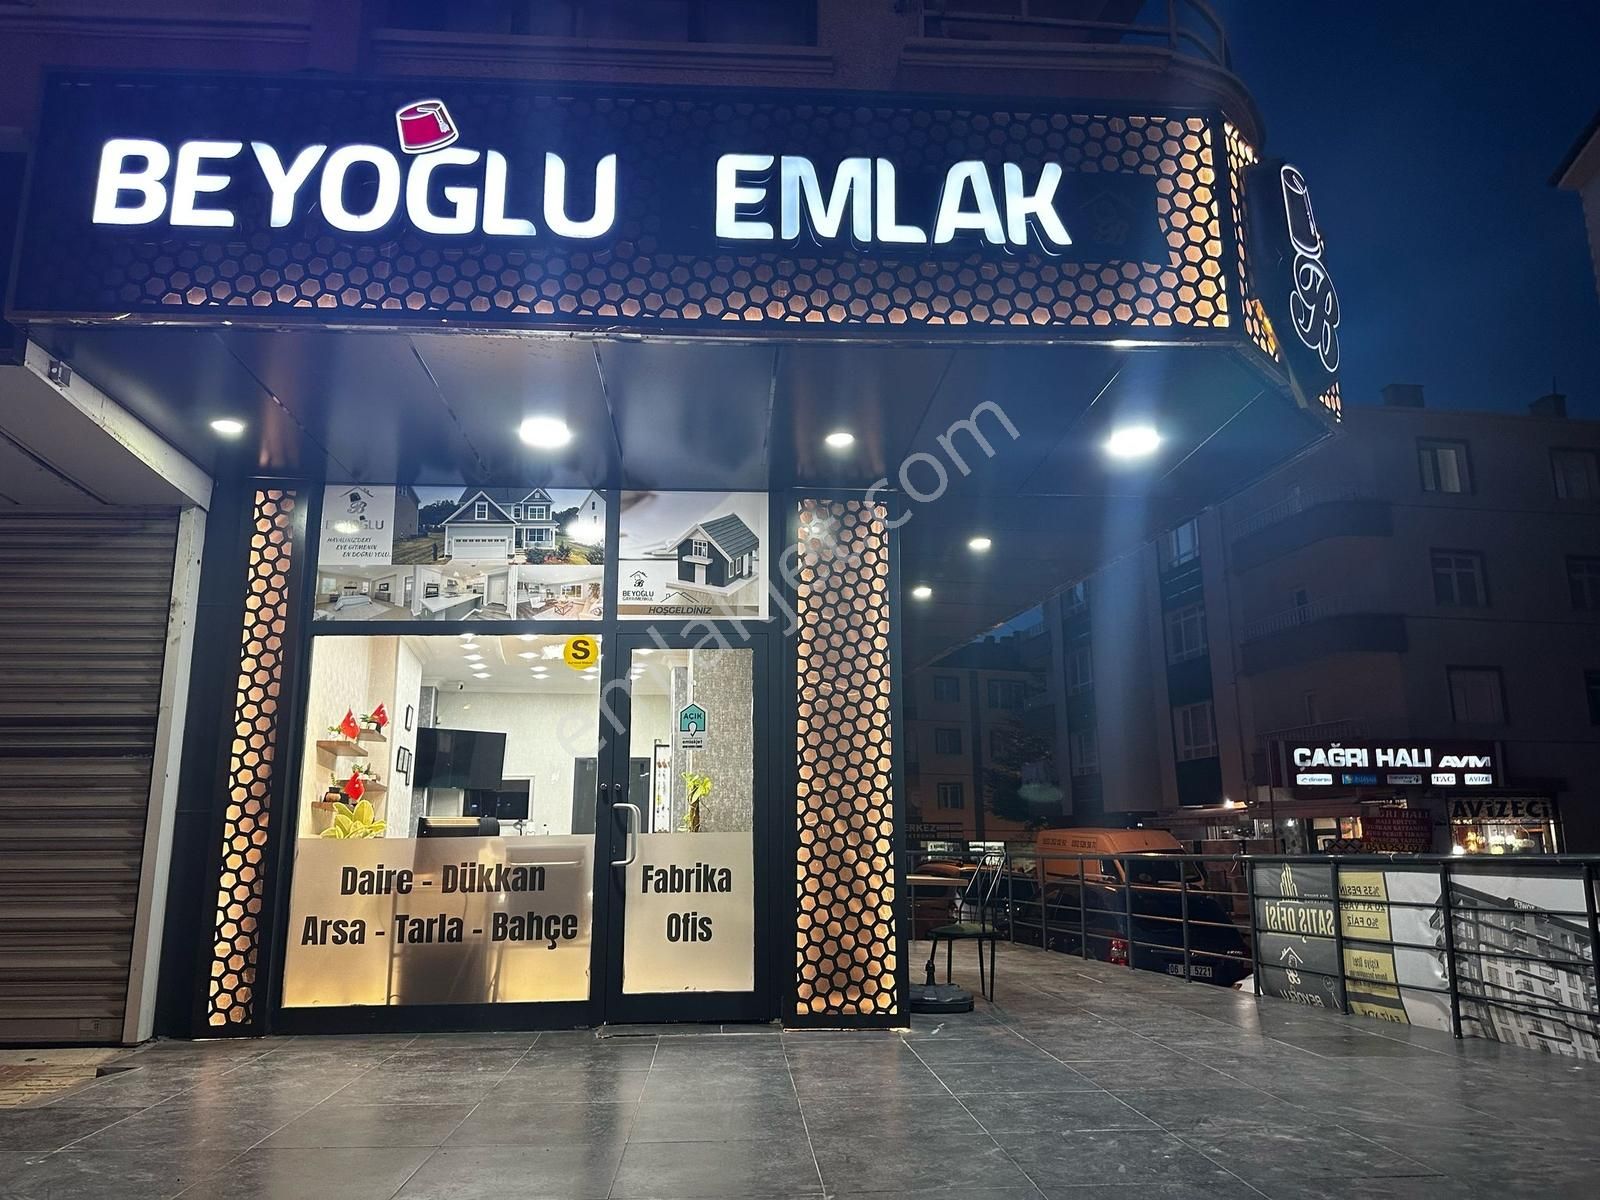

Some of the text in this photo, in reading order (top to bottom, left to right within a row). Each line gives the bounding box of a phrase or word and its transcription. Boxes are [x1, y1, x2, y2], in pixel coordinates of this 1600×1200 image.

[715, 153, 1073, 246] EMLAK
[572, 639, 590, 660] S
[1293, 742, 1491, 771] ÇAĞRI HALI AVM
[340, 864, 414, 896] Daire
[441, 863, 545, 894] Dükkan
[641, 864, 733, 894] Fabrika
[301, 915, 366, 946] Arsa
[394, 913, 464, 944] Tarla
[492, 911, 578, 950] Bahçe
[666, 912, 713, 943] Ofis
